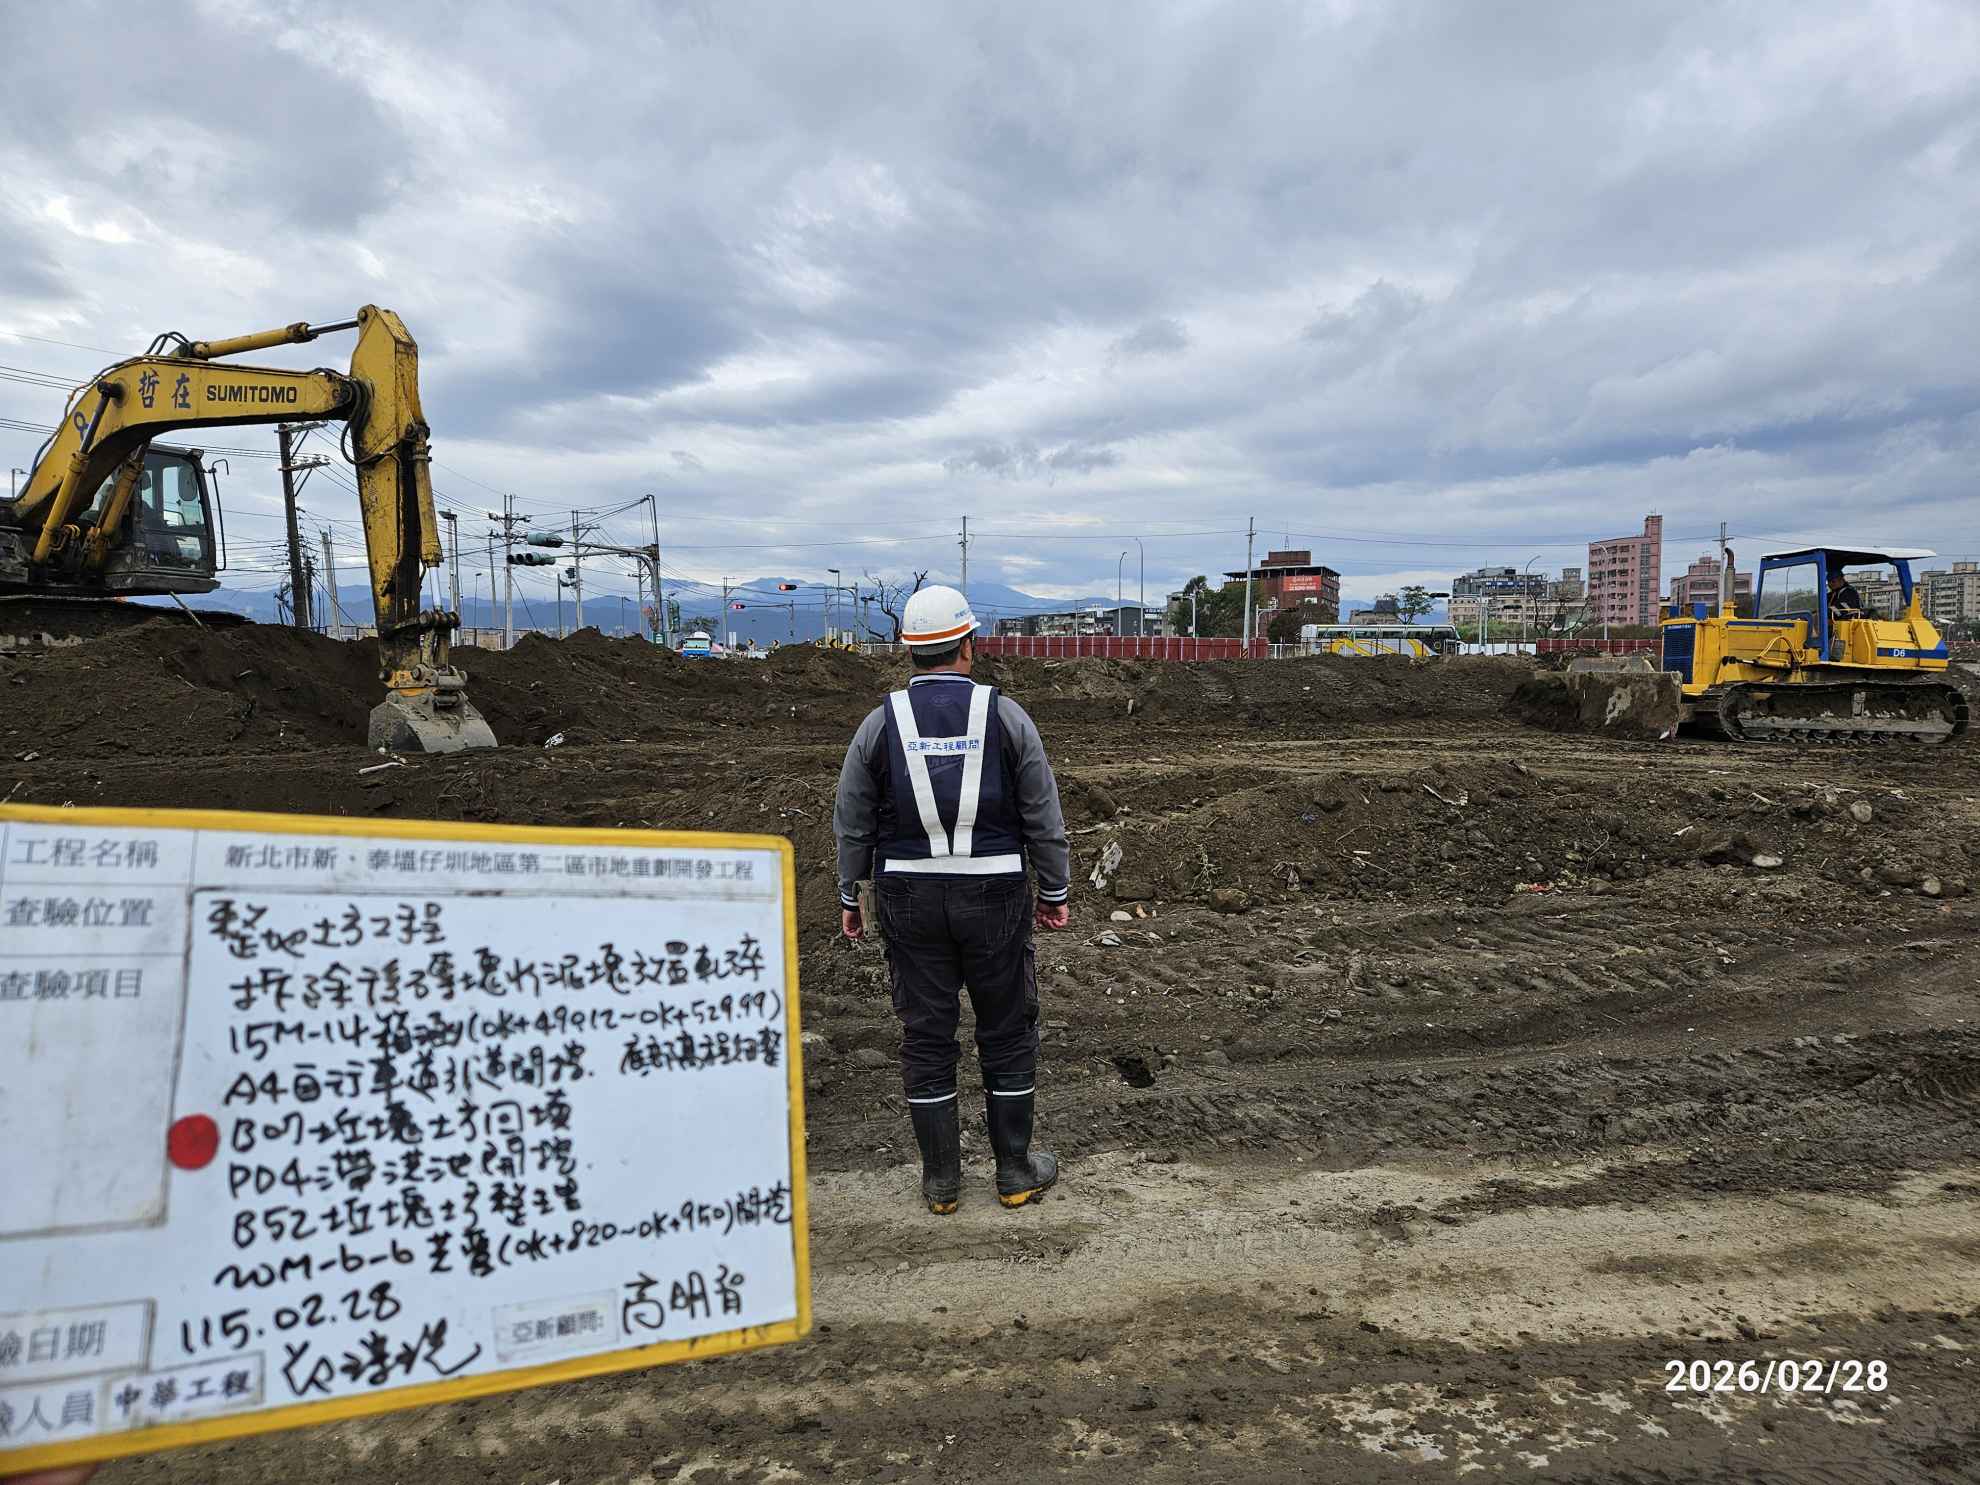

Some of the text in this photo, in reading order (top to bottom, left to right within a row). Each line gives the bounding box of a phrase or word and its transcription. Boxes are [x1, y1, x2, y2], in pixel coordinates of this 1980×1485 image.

[206, 384, 298, 404] SUMITOMO
[10, 837, 159, 869] 工程名稱
[3, 896, 154, 928] 查驗位置
[0, 968, 143, 1001] 查驗項目
[181, 1282, 401, 1354] 115.02.28
[115, 1370, 254, 1417] 中華工程
